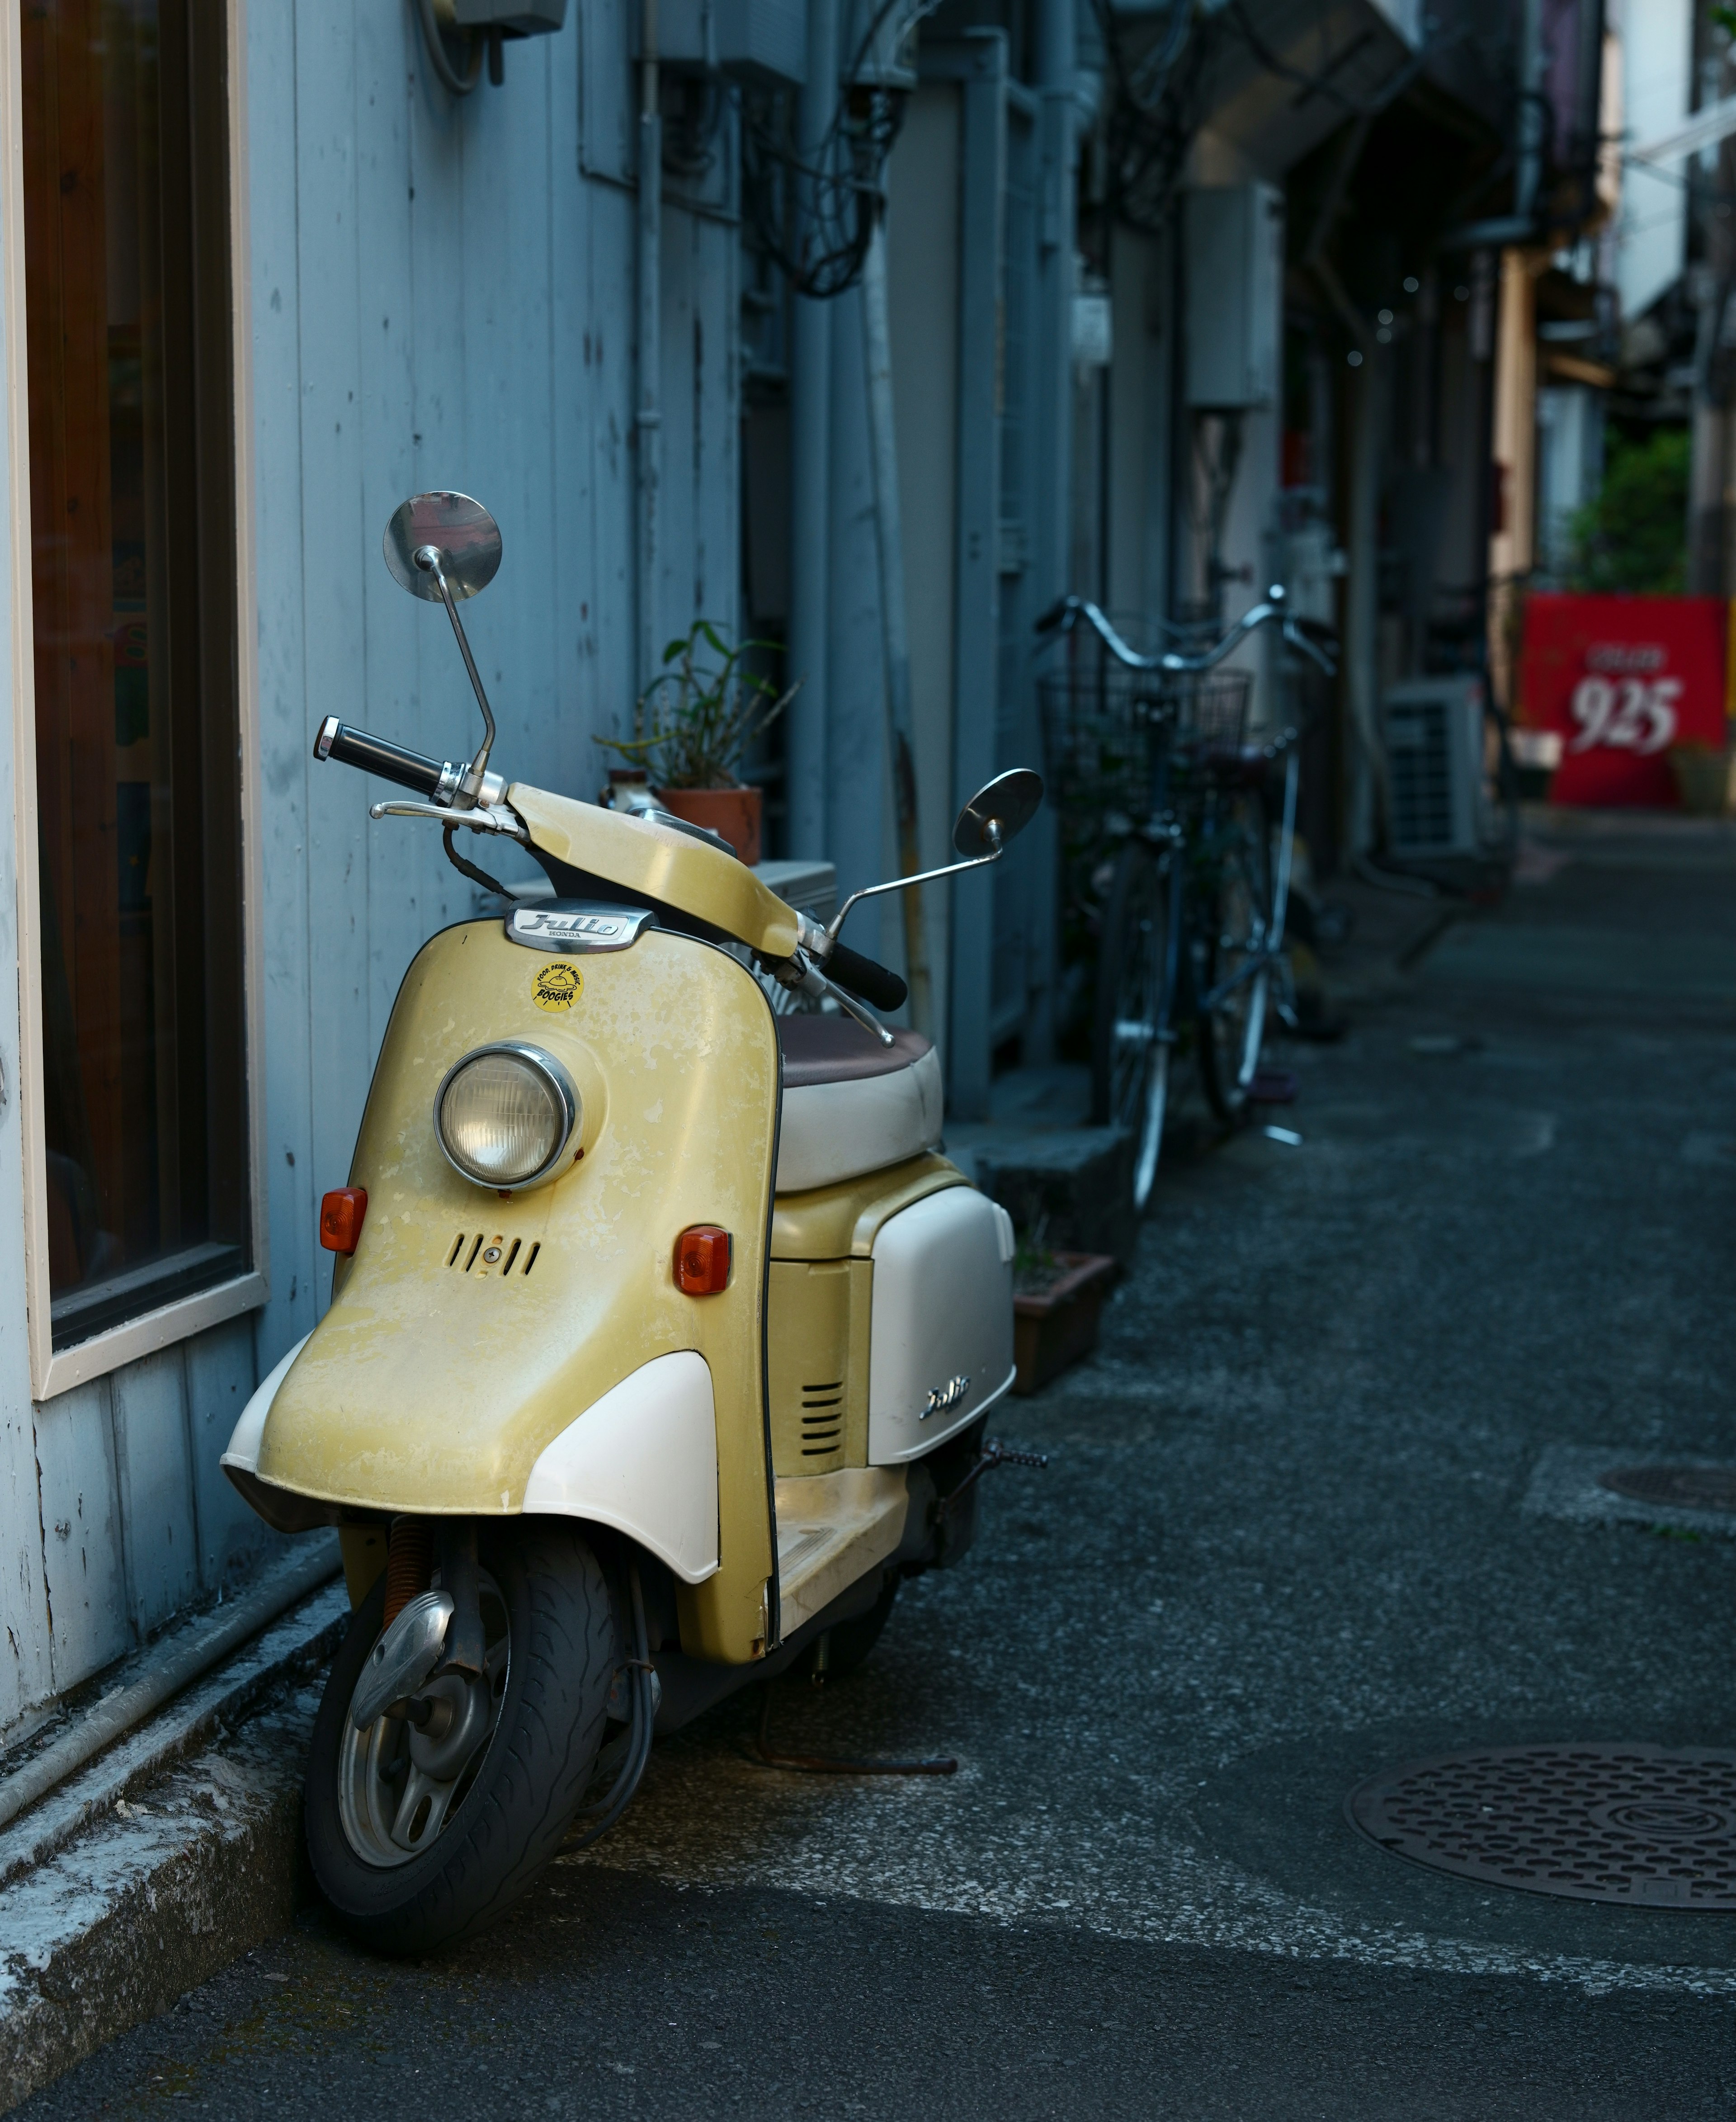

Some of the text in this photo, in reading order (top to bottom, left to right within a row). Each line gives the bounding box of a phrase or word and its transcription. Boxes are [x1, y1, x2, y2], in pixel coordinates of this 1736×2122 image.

[1571, 677, 1684, 756] 925
[520, 914, 618, 935] Julio
[570, 970, 580, 985] MUSIC
[537, 989, 573, 1001] BOOGIES
